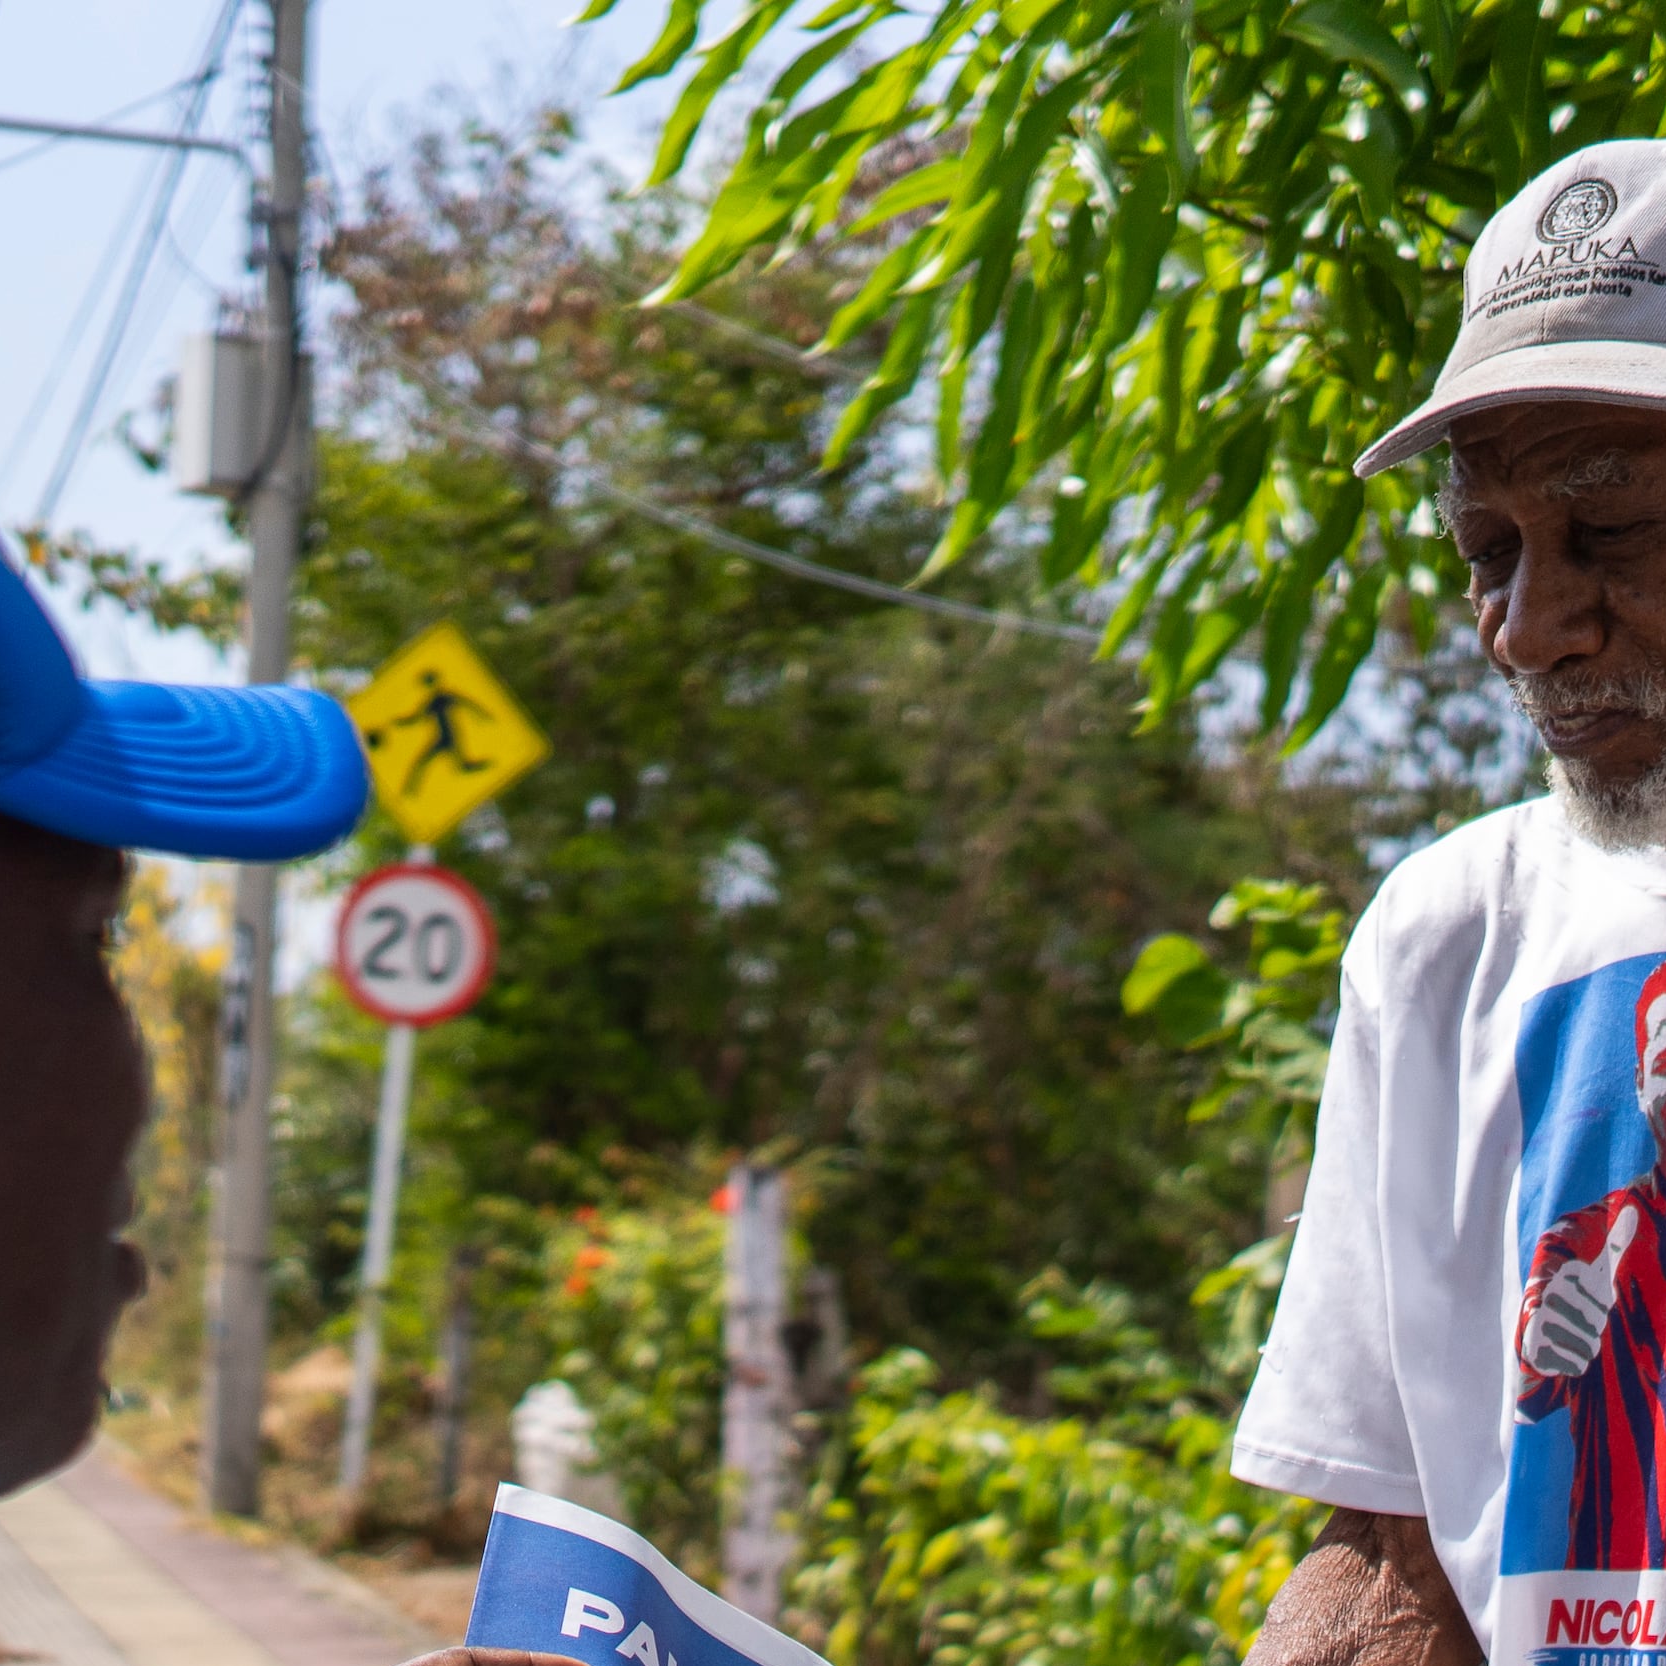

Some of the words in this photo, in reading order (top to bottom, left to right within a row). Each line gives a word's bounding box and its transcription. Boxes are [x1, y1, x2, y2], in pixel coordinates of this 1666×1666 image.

[1496, 237, 1640, 285] MAPUKA
[1564, 280, 1587, 298] del
[360, 904, 464, 985] 20
